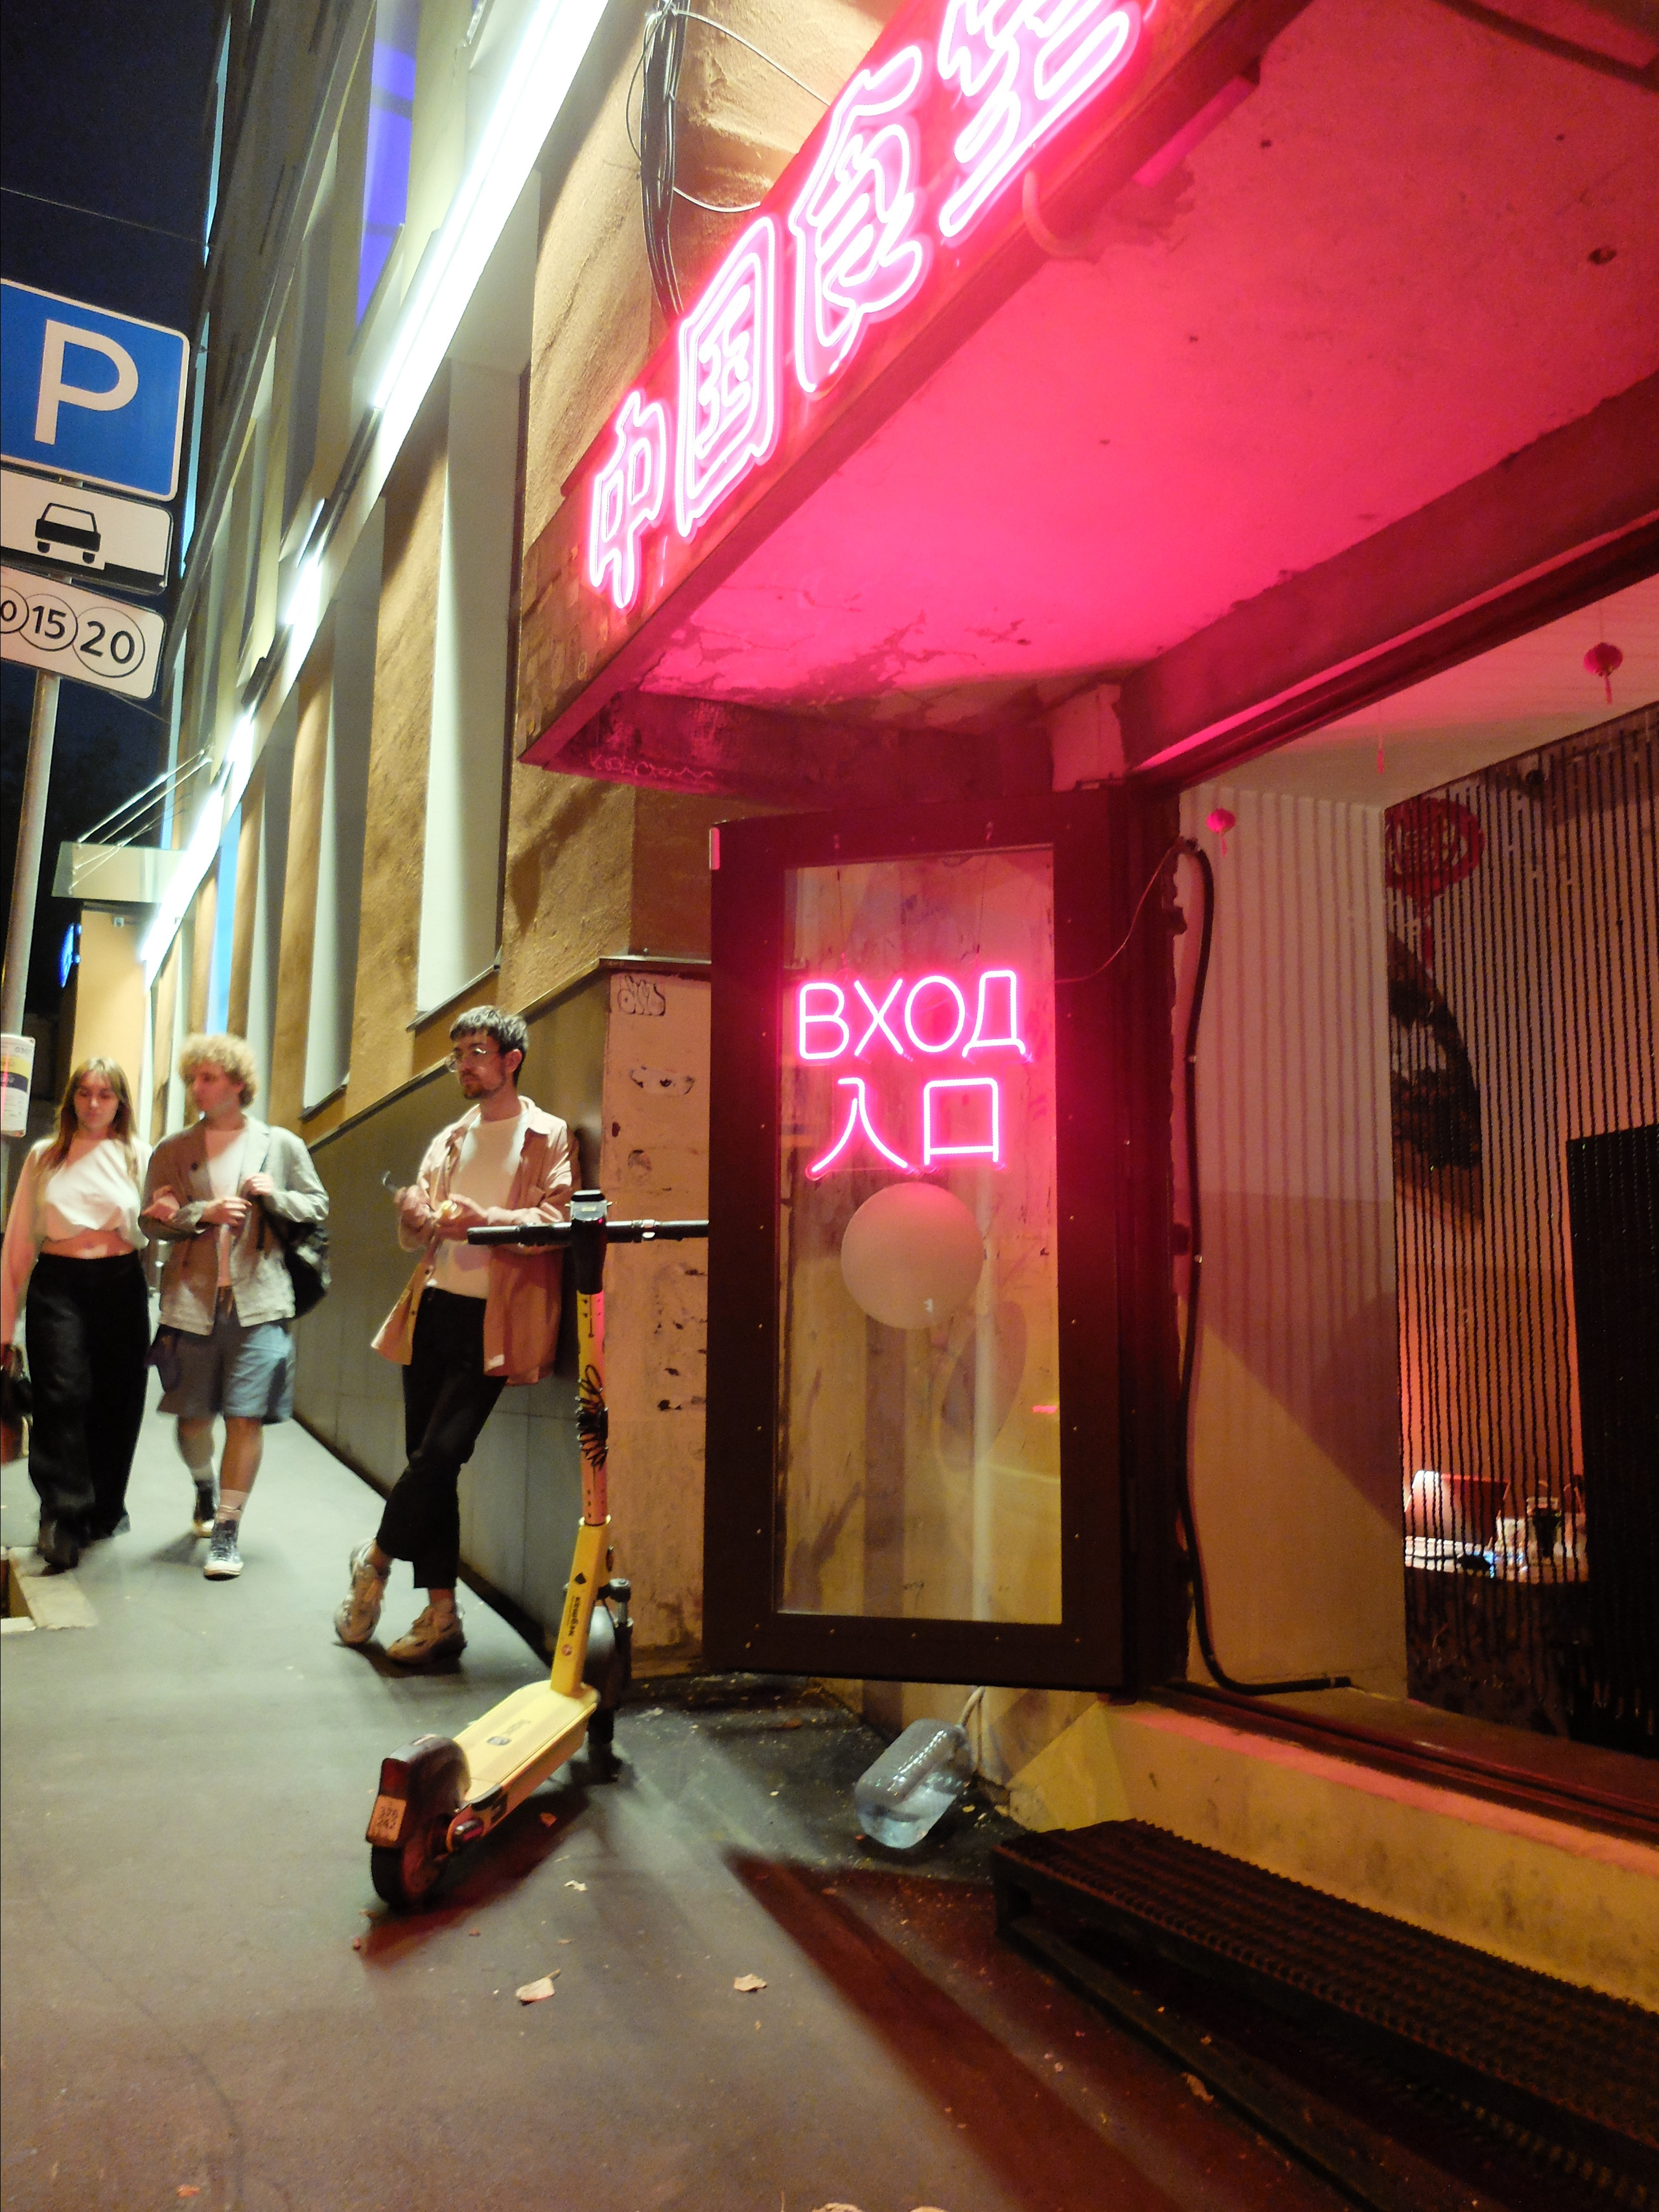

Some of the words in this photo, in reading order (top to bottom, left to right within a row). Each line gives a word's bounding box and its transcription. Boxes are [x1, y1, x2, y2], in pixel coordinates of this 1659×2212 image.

[34, 320, 138, 445] P
[32, 605, 67, 640] 15
[80, 620, 135, 664] 20
[798, 970, 1027, 1060] ВХОД
[808, 1077, 999, 1174] 入口
